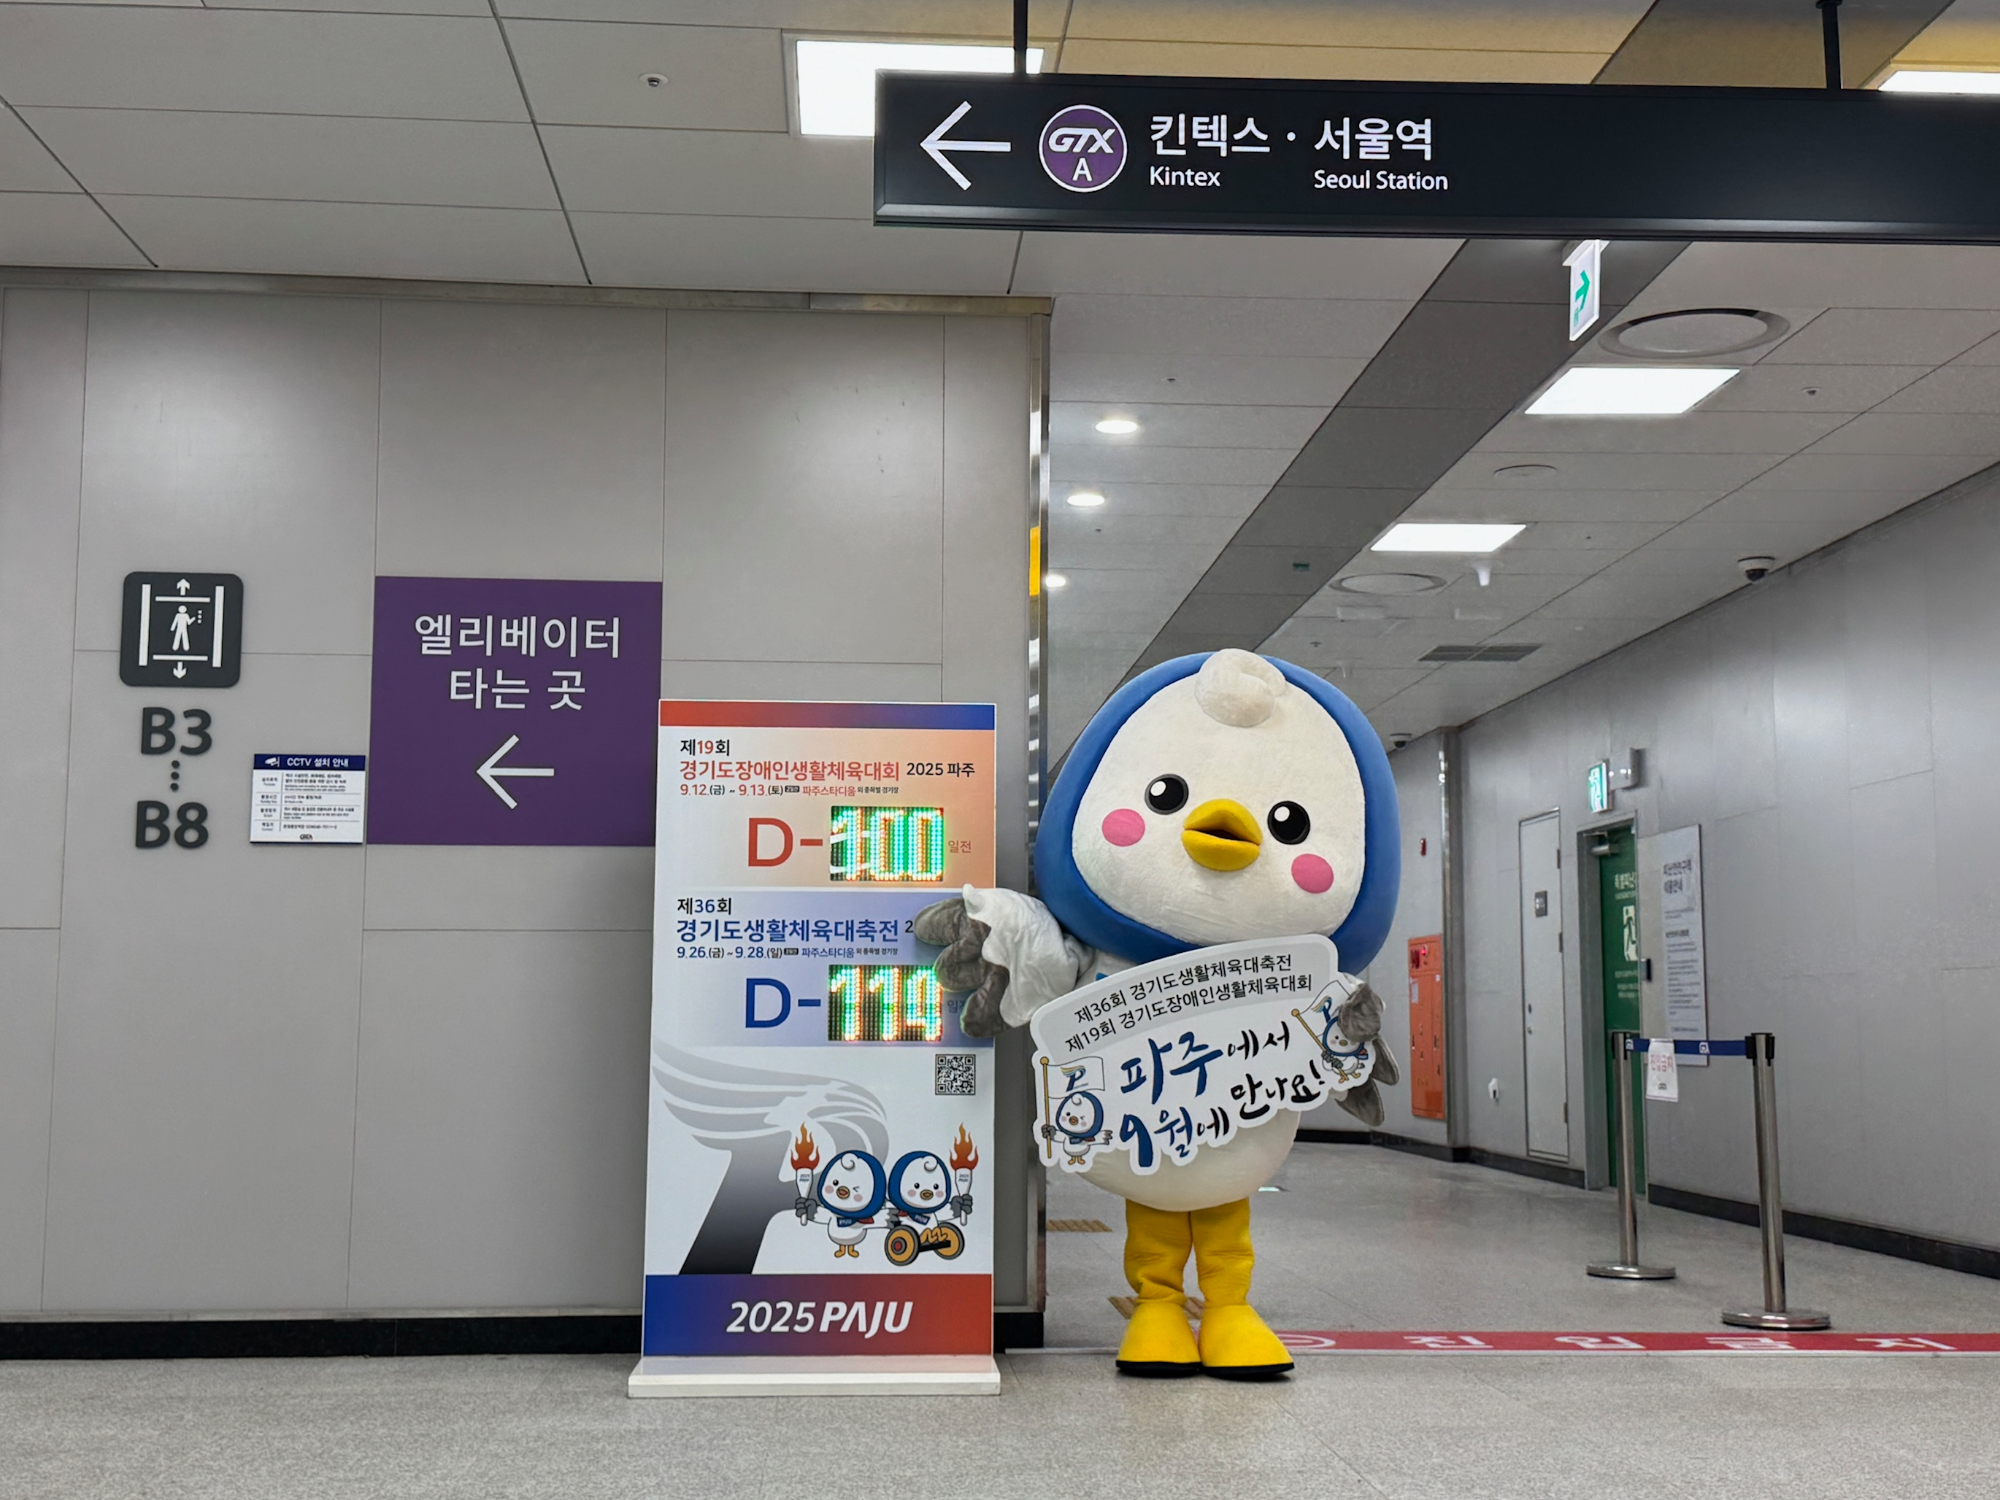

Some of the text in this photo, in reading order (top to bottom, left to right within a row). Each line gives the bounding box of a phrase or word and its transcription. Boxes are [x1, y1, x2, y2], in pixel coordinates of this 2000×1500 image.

[1049, 127, 1116, 154] GTX
[1150, 113, 1270, 157] 킨텍스
[1314, 116, 1432, 161] 서울역
[1072, 157, 1093, 182] A
[1150, 166, 1221, 187] Kintex
[1314, 169, 1448, 190] Seoul Station
[413, 613, 621, 659] 엘리베이터
[449, 668, 586, 712] 타는 곳
[140, 706, 212, 756] B3
[680, 738, 730, 757] 제19회
[286, 757, 349, 768] CCTV 설치 안내
[679, 760, 975, 782] 경기도장애인생활체육대회 2025 파주
[802, 785, 856, 798] 파주스타디움
[881, 787, 899, 795] 경기장
[135, 800, 209, 849] B8
[948, 840, 972, 854] 일전
[677, 897, 732, 915] 제36회
[676, 919, 899, 943] 경기도생활체육대축전
[801, 946, 855, 959] 파주스타디움
[1074, 954, 1292, 1024] 제36회 경기도생활체육대축전
[1064, 973, 1312, 1053] 제19회 경기도장애인생활체육대회
[1120, 1020, 1291, 1105] 파주에서
[1119, 1058, 1326, 1168] 9월에 만나요!
[726, 1301, 914, 1339] 2025 PAJU
